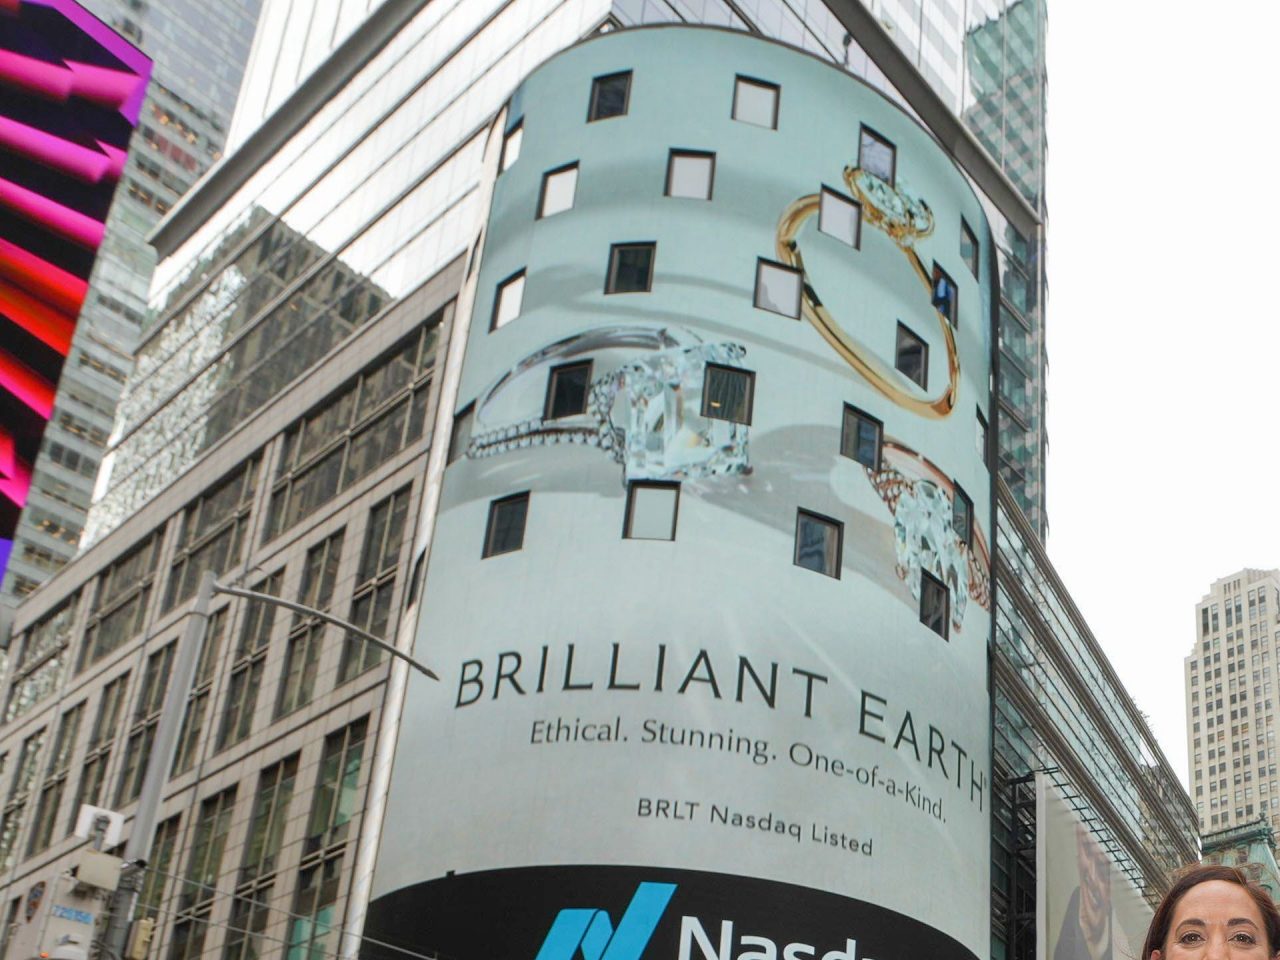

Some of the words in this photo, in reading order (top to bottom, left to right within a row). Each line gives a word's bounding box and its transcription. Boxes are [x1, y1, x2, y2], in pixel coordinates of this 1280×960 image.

[453, 642, 829, 720] BRILLIANT
[530, 716, 628, 746] Ethical.
[641, 718, 777, 766] Stunning.
[788, 743, 948, 824] One-of-a-Kind.
[637, 798, 701, 822] BRLT
[709, 804, 803, 844] Nasdaq
[810, 825, 875, 858] Listed
